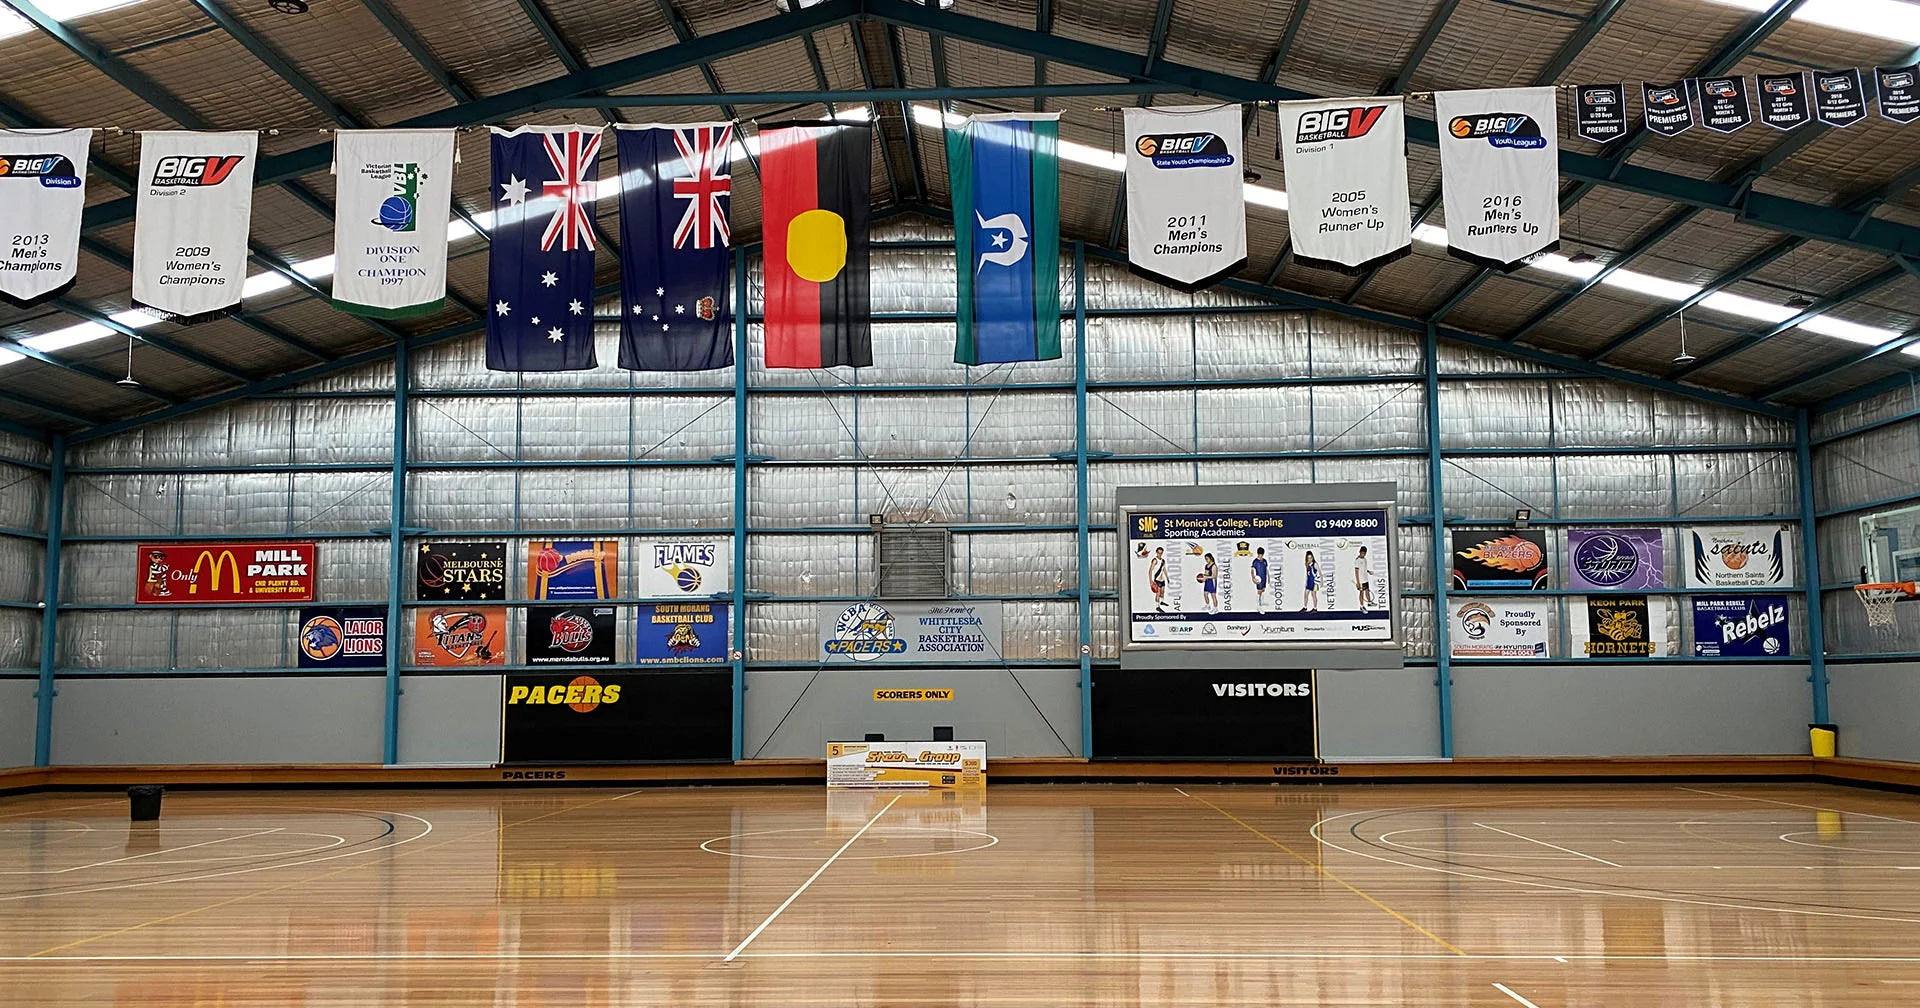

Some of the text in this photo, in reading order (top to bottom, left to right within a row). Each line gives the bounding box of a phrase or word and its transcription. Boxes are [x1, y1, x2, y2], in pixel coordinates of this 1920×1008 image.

[1825, 110, 1857, 118] PREMIERS
[1887, 106, 1920, 115] PREMIERS
[1649, 112, 1688, 124] PREMIERS
[1710, 115, 1742, 125] PREMIERS
[1768, 113, 1801, 122] PREMIERS
[1298, 131, 1345, 141] BASKETBALL
[1586, 126, 1618, 134] PREMIERS
[1513, 139, 1537, 147] League
[1296, 145, 1326, 154] Division
[393, 163, 407, 196] VBL
[1332, 190, 1366, 203] 2005
[1483, 195, 1522, 208] 2016
[1321, 204, 1378, 218] Women's
[1484, 208, 1521, 221] Men's
[1167, 215, 1206, 228] 2011
[1319, 219, 1384, 233] Runner Up
[1168, 227, 1208, 240] Men's
[1467, 223, 1539, 236] Runners Up
[12, 234, 49, 246] 2013
[11, 246, 47, 258] Men's
[175, 247, 211, 257] 2009
[366, 246, 420, 255] DIVISION
[1153, 241, 1223, 255] Champions
[380, 255, 406, 263] ONE
[166, 261, 221, 271] Women's
[358, 268, 427, 277] CHAMPION
[160, 274, 225, 286] Champions
[381, 277, 404, 285] 1997
[1138, 517, 1158, 532] SMC
[1164, 518, 1284, 528] St Monica's College, Epping
[1315, 518, 1378, 528] 03 9409 8800
[1164, 528, 1200, 538] Sporting
[1201, 527, 1246, 537] Academies
[1710, 540, 1768, 555] saints
[255, 550, 302, 562] MILL
[654, 545, 715, 568] FLAMES
[1483, 550, 1534, 559] BLAZERS
[443, 560, 503, 568] MELBOURNE
[171, 569, 198, 583] Only
[247, 564, 308, 577] PARK
[443, 568, 503, 583] STARS
[1223, 559, 1232, 611] BASKETBALL
[1275, 567, 1283, 611] FOOTBALL
[1327, 573, 1335, 610] NETBALL
[1378, 578, 1386, 609] TENNIS
[655, 604, 710, 613] SOUTH MORANG
[1505, 610, 1536, 619] Proudly
[651, 614, 714, 623] BASKETBALL CLUB
[836, 604, 867, 632] WCBA
[919, 617, 983, 625] WHITTLESEA
[1500, 619, 1541, 628] Sponsored
[1723, 605, 1785, 643] Rebelz
[344, 620, 384, 636] LALOR
[939, 625, 963, 634] CITY
[1515, 628, 1527, 636] By
[434, 631, 484, 646] TITANS
[919, 634, 984, 643] BASKETBALL
[343, 638, 383, 654] LIONS
[837, 640, 892, 653] PACERS
[917, 643, 985, 652] ASSOCIATION
[1584, 642, 1656, 654] HORNETS
[640, 656, 724, 664] www.smbclions.com
[508, 685, 622, 704] PACERS
[876, 691, 951, 699] SCORERS ONLY
[1212, 683, 1310, 697] VISITORS
[832, 745, 839, 756] 5
[919, 751, 961, 764] Group
[502, 770, 566, 780] PACERS
[1273, 767, 1339, 775] VISITORS
